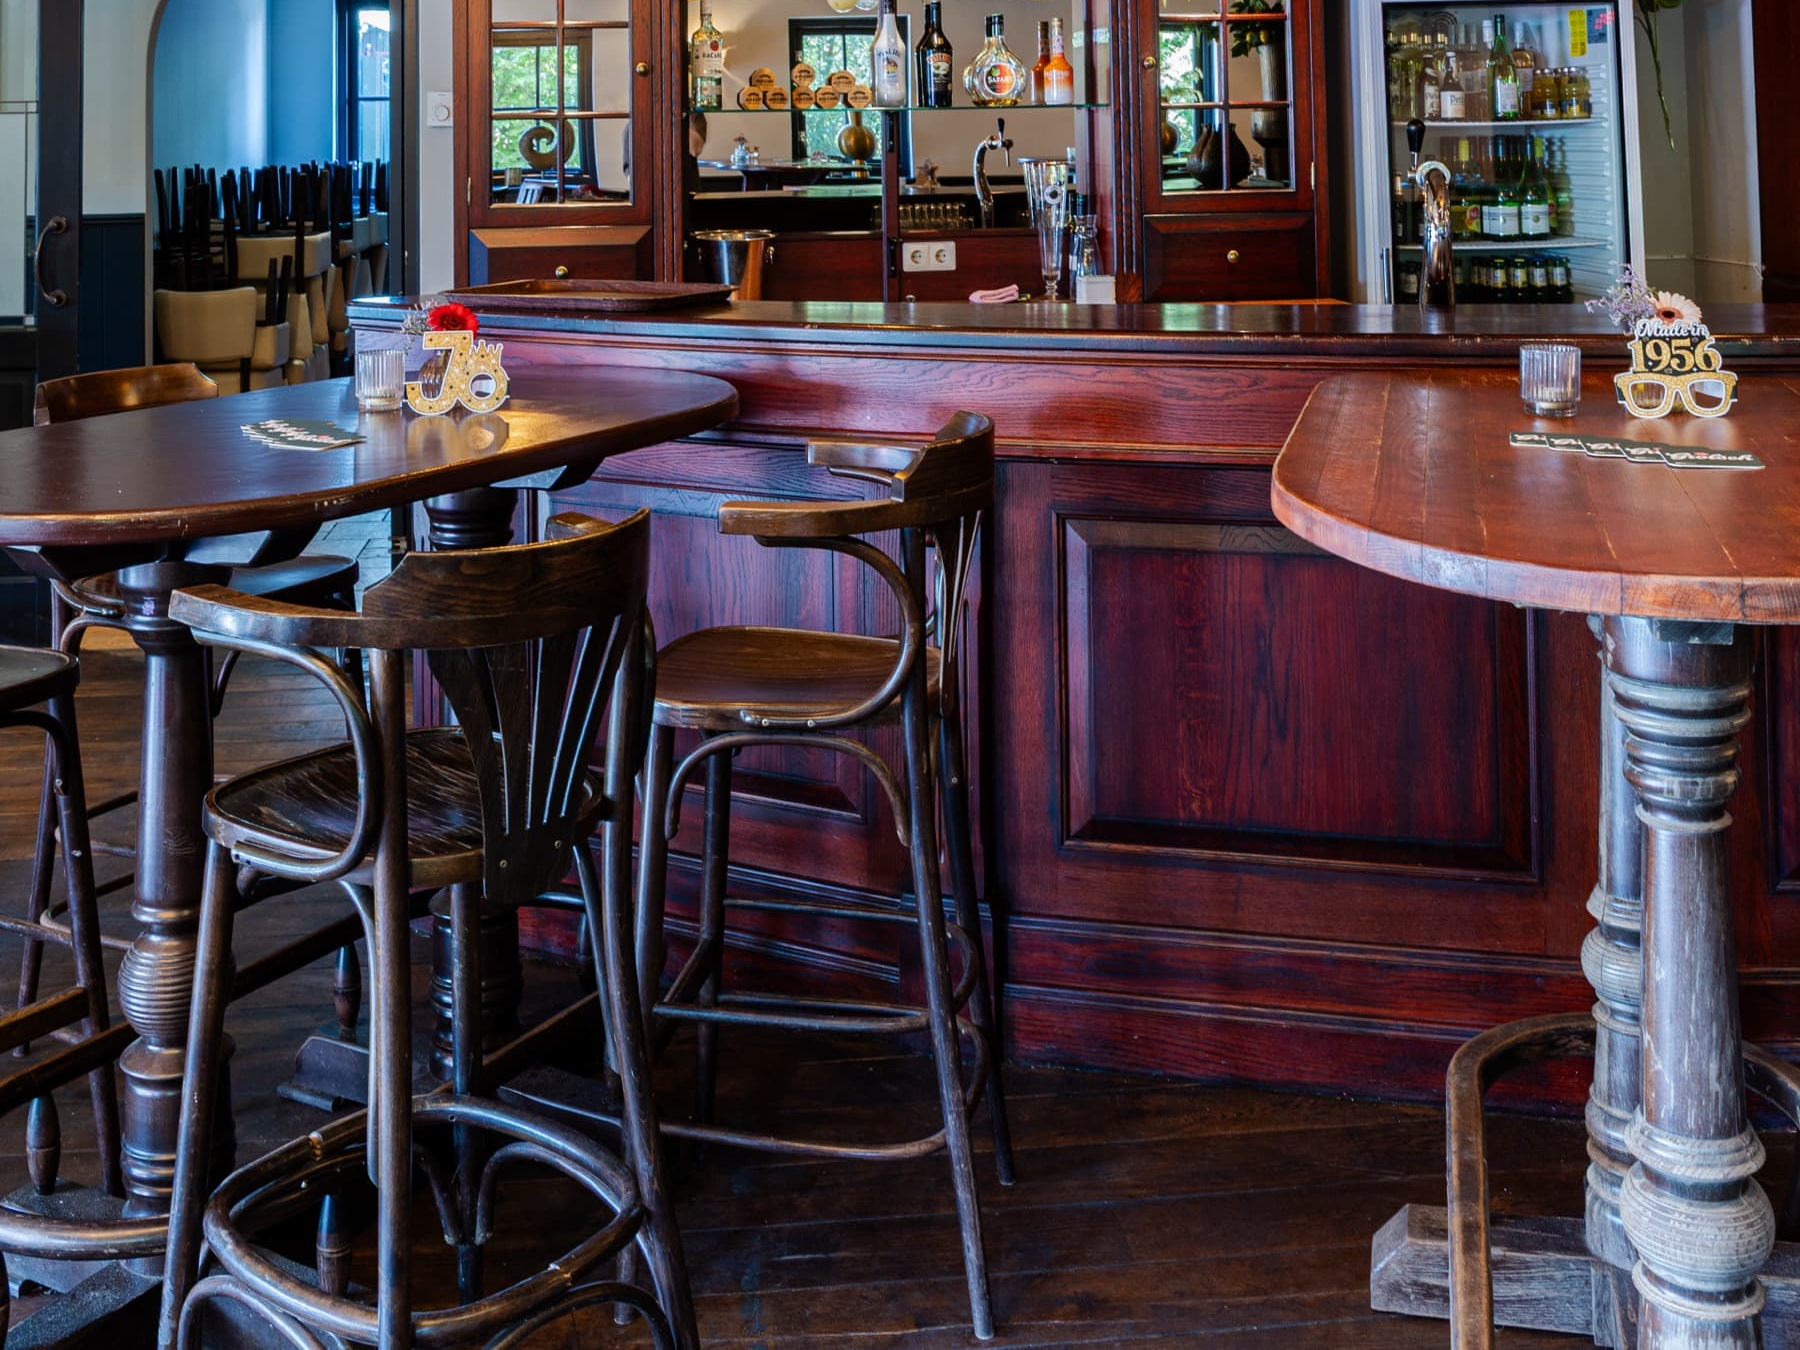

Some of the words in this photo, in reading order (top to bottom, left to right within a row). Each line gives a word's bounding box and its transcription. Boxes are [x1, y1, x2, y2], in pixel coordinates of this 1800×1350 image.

[1637, 319, 1690, 337] Made
[1690, 320, 1708, 338] in
[1631, 337, 1719, 372] 1956
